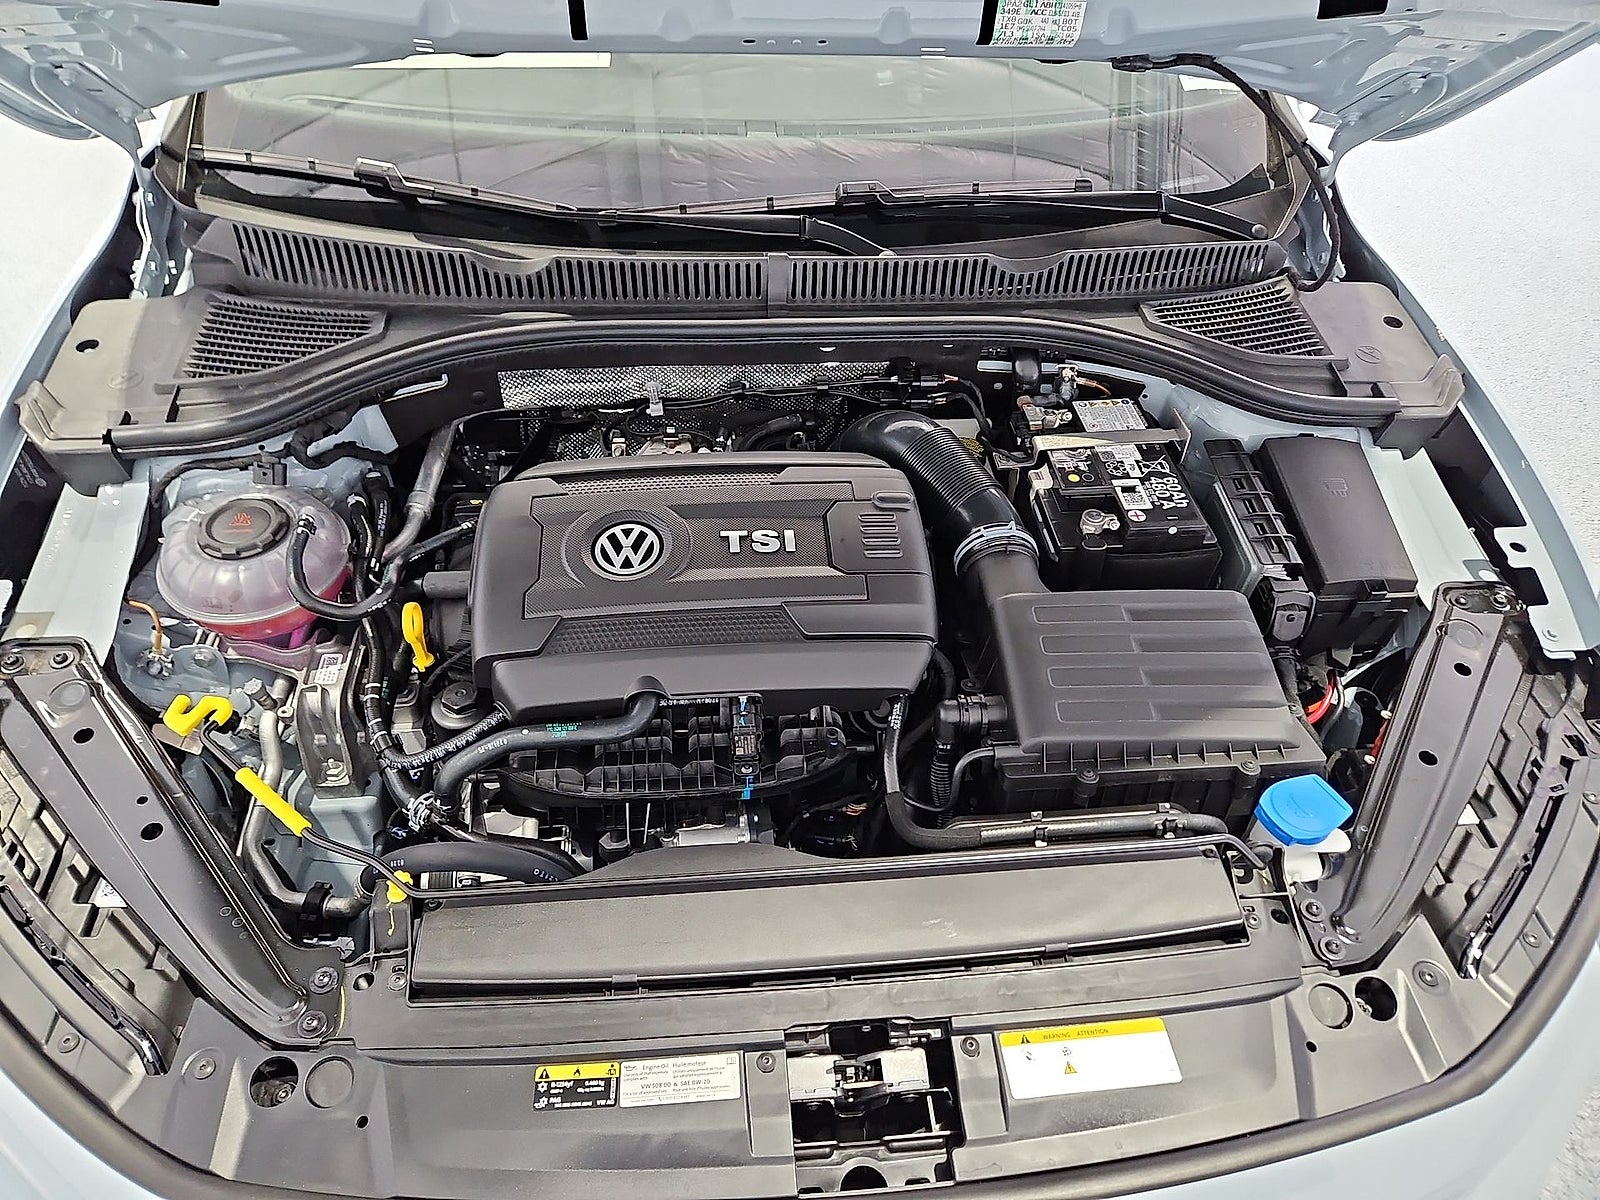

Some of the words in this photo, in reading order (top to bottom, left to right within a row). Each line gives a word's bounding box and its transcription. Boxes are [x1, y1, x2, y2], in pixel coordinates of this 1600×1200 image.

[1150, 476, 1170, 498] 480
[1163, 477, 1190, 508] 60Ah
[1159, 499, 1176, 510] A
[719, 529, 797, 554] TSI
[1043, 1031, 1071, 1040] WARNING
[1077, 1028, 1109, 1037] ATTENTION
